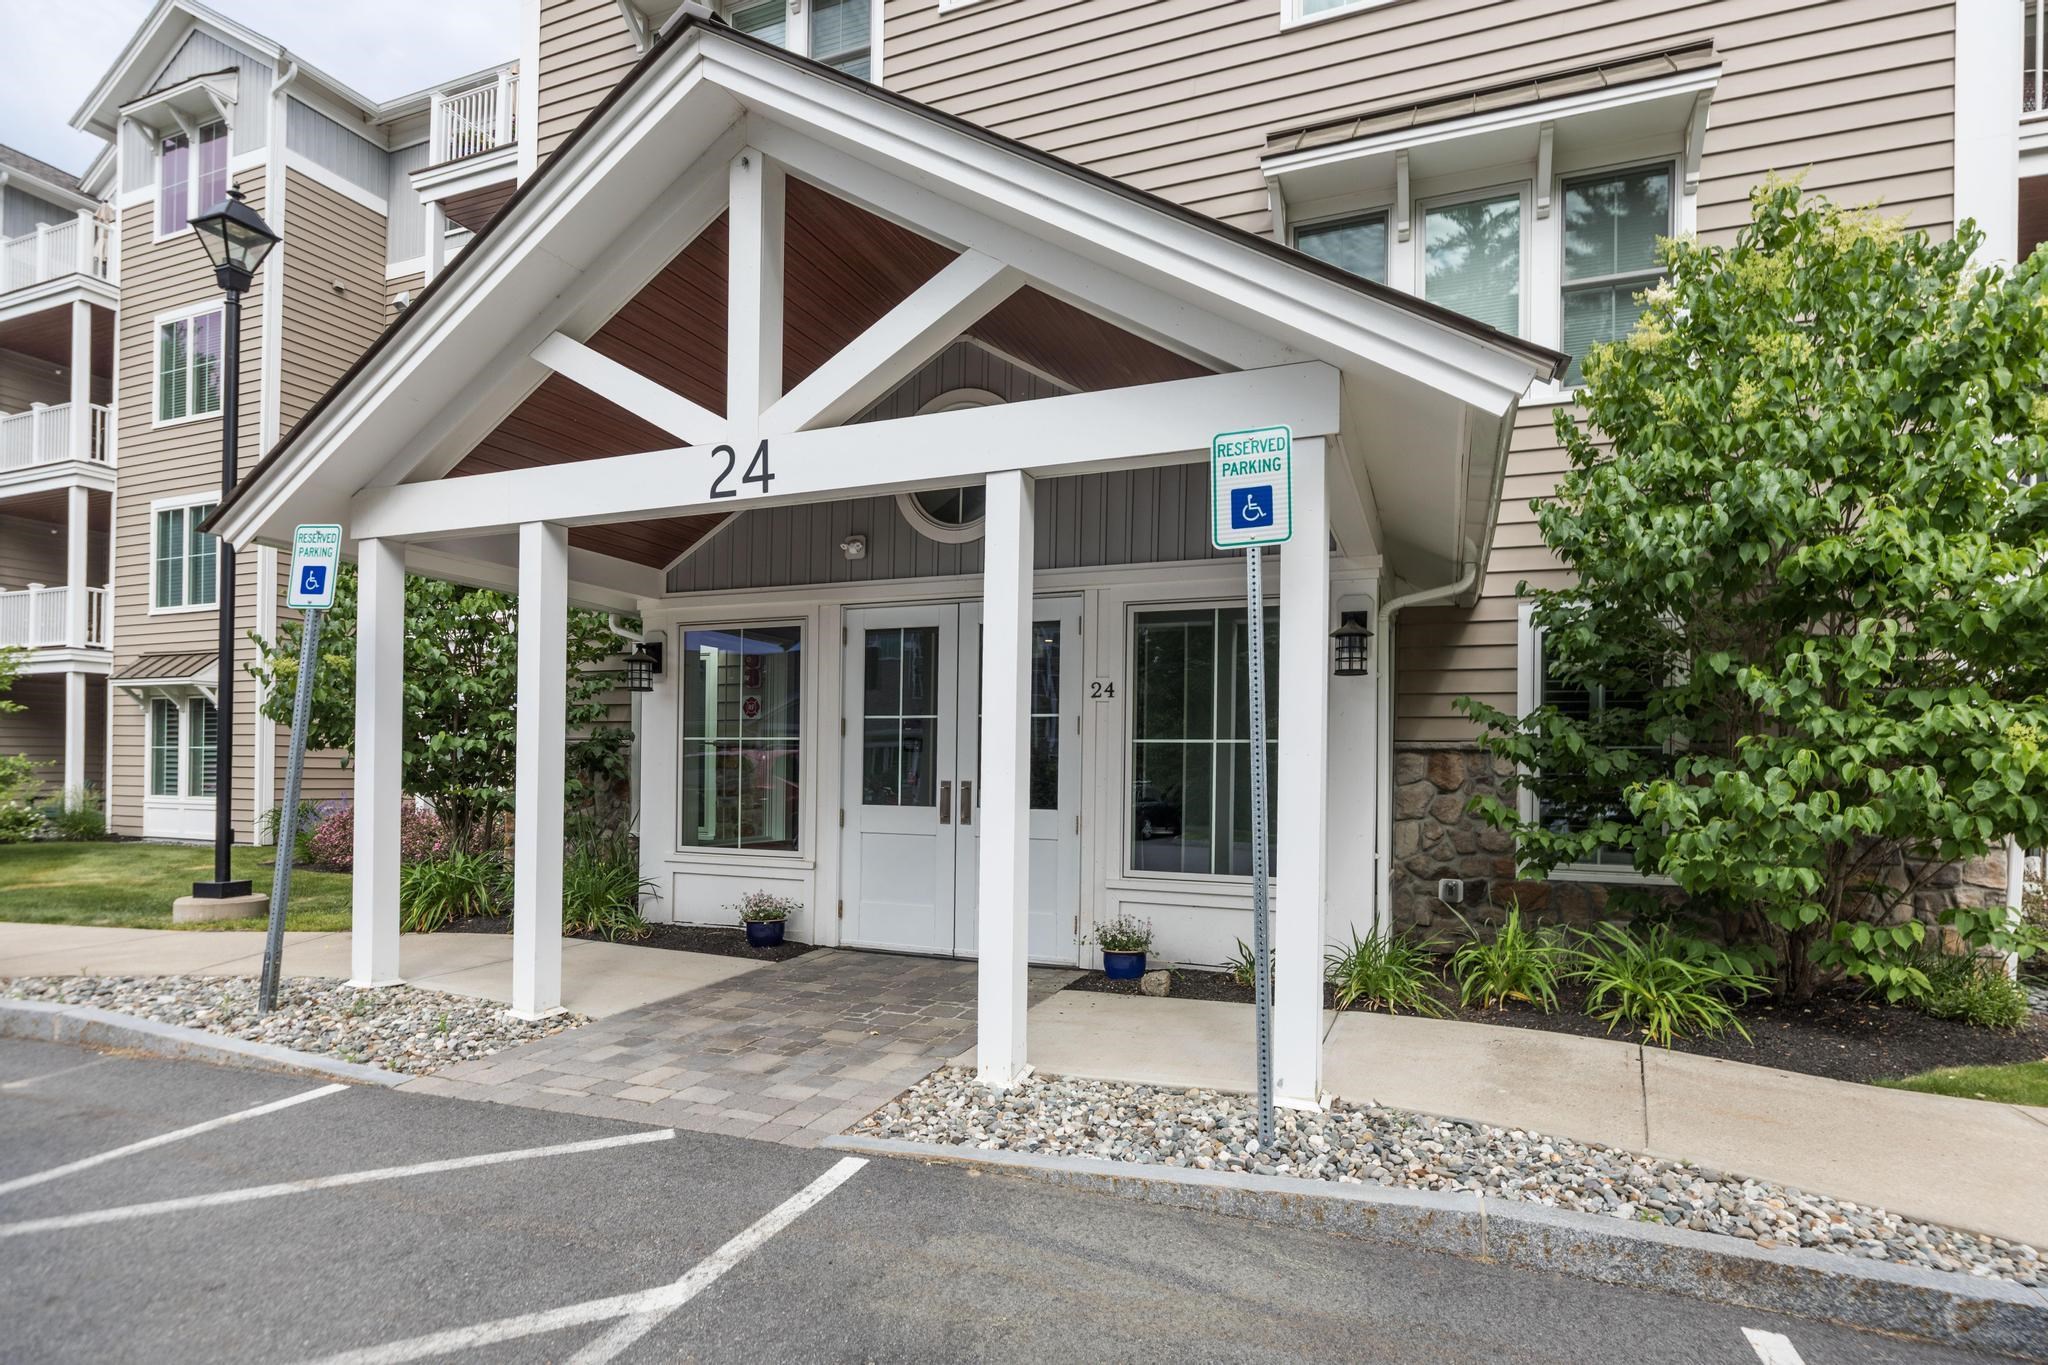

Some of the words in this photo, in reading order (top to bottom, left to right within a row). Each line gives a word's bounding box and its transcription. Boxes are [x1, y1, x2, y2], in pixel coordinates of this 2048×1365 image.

[1217, 437, 1286, 458] RESERVED
[710, 439, 775, 499] 24
[1222, 457, 1281, 477] PARKING
[297, 533, 337, 544] RESERVED
[298, 547, 333, 558] PARKING
[1090, 681, 1115, 699] 24
